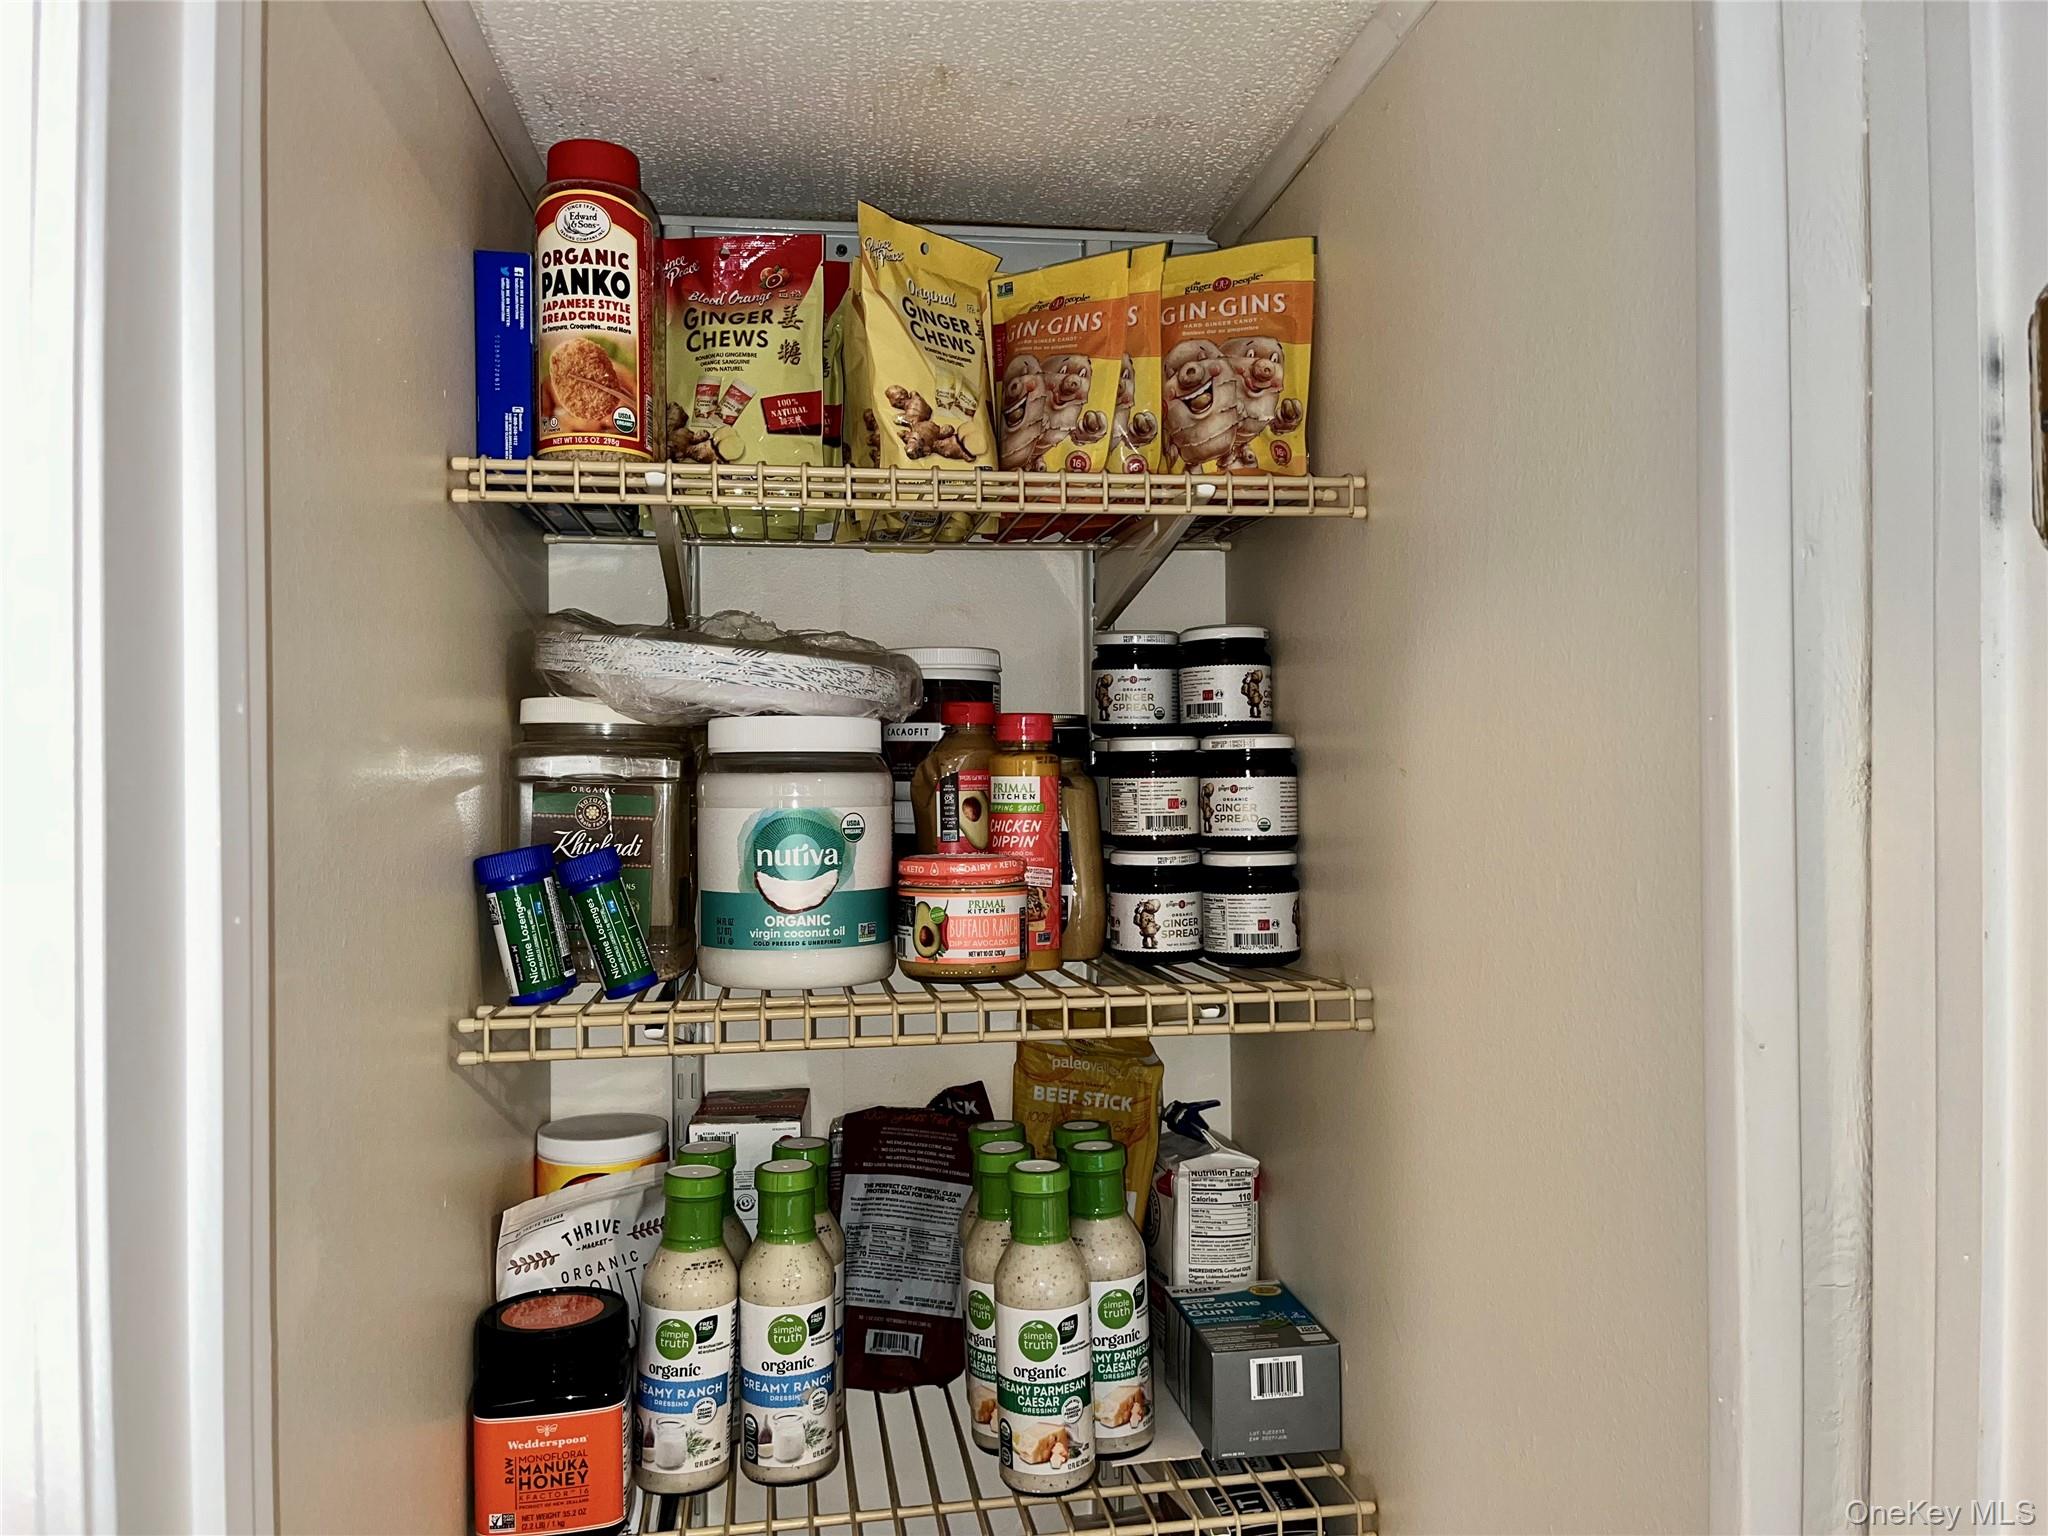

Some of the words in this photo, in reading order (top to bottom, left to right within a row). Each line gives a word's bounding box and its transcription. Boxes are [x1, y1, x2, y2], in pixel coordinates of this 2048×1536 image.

[569, 211, 598, 222] Edward
[542, 247, 630, 270] ORGANIC
[542, 268, 631, 299] PANKO
[1184, 282, 1212, 295] ginger
[1232, 273, 1260, 289] people
[688, 290, 727, 306] Blood
[728, 290, 773, 308] Orange
[907, 277, 957, 308] Original
[543, 298, 595, 313] JAPANESE
[598, 299, 631, 314] STYLE
[542, 311, 631, 326] BREADCRUMBS
[684, 306, 774, 330] GINGER
[902, 296, 973, 337] GINGER
[1205, 320, 1232, 328] GINGER
[1233, 317, 1258, 326] CANDY
[607, 324, 618, 332] and
[686, 329, 769, 353] CHEWS
[910, 320, 976, 355] CHEWS
[700, 359, 721, 367] ORANGE
[777, 398, 798, 408] 100%
[618, 412, 631, 420] USDA
[771, 406, 808, 418] NATURAL
[1114, 693, 1154, 702] GINGER
[1112, 703, 1155, 711] SPREAD
[887, 727, 929, 737] CACAOFIT
[570, 785, 616, 794] ORGANIC
[993, 782, 1035, 794] PRIMAL
[1215, 803, 1257, 812] GINGER
[846, 819, 860, 827] USDA
[1214, 814, 1259, 823] SPREAD
[990, 818, 1042, 833] CHICKEN
[992, 835, 1039, 848] DIPPIN'
[757, 843, 839, 867] nutiva
[907, 865, 924, 873] KETO
[966, 863, 992, 874] DAIRY
[999, 860, 1018, 869] KETO
[968, 899, 1005, 908] PRIMAL
[512, 896, 531, 942] Lozenges
[586, 897, 607, 940] Lozenges
[764, 914, 831, 928] ORGANIC
[1162, 918, 1199, 928] GINGER
[750, 926, 781, 940] virgin
[783, 926, 831, 938] coconut
[832, 926, 845, 936] oil
[950, 918, 989, 938] BUFFALO
[992, 918, 1018, 937] RANCH
[1161, 929, 1199, 939] SPREAD
[808, 938, 842, 946] UNREFINED
[971, 938, 1008, 947] AVOCADO
[523, 943, 540, 984] Nicotine
[601, 940, 622, 979] Nicotine
[1033, 1085, 1079, 1104] BEEF
[1082, 1090, 1134, 1112] STICK
[1191, 1169, 1228, 1177] Nutrition
[1230, 1169, 1252, 1177] Facts
[942, 1190, 961, 1198] CLEAN
[1191, 1195, 1218, 1203] Calories
[1239, 1192, 1251, 1202] 110
[561, 1219, 621, 1247] THRIVE
[582, 1237, 608, 1251] MARKET
[561, 1250, 639, 1284] ORGANIC
[1171, 1286, 1222, 1294] equate
[1103, 1299, 1130, 1310] simple
[1181, 1299, 1262, 1311] Nicotine
[970, 1307, 991, 1320] truth
[1103, 1307, 1131, 1319] truth
[1187, 1308, 1234, 1318] Gum
[661, 1330, 689, 1340] simple
[773, 1325, 802, 1335] simple
[660, 1338, 689, 1349] truth
[773, 1333, 803, 1344] truth
[1023, 1332, 1052, 1342] simple
[1092, 1328, 1141, 1349] organic
[1023, 1339, 1053, 1350] truth
[649, 1363, 701, 1379] organic
[761, 1356, 815, 1375] organic
[1097, 1358, 1137, 1374] CAESAR
[1013, 1364, 1067, 1382] organic
[1103, 1370, 1135, 1380] DRESSING
[743, 1376, 791, 1394] CREAMY
[794, 1372, 832, 1393] RANCH
[998, 1376, 1032, 1395] CREAMY
[1033, 1377, 1086, 1396] PARMESAN
[677, 1381, 723, 1399] RANCH
[654, 1399, 689, 1407] DRESSING
[769, 1394, 801, 1402] DRESSIN
[1017, 1396, 1060, 1407] CAESAR
[507, 1435, 588, 1450] Wedderspoon
[519, 1449, 588, 1463] MONOFLORAL
[505, 1458, 514, 1484] RAW
[519, 1458, 588, 1475] MANUKA
[519, 1470, 588, 1491] HONEY
[521, 1514, 535, 1522] NET
[536, 1511, 561, 1520] WEIGHT
[562, 1509, 576, 1518] 35.2
